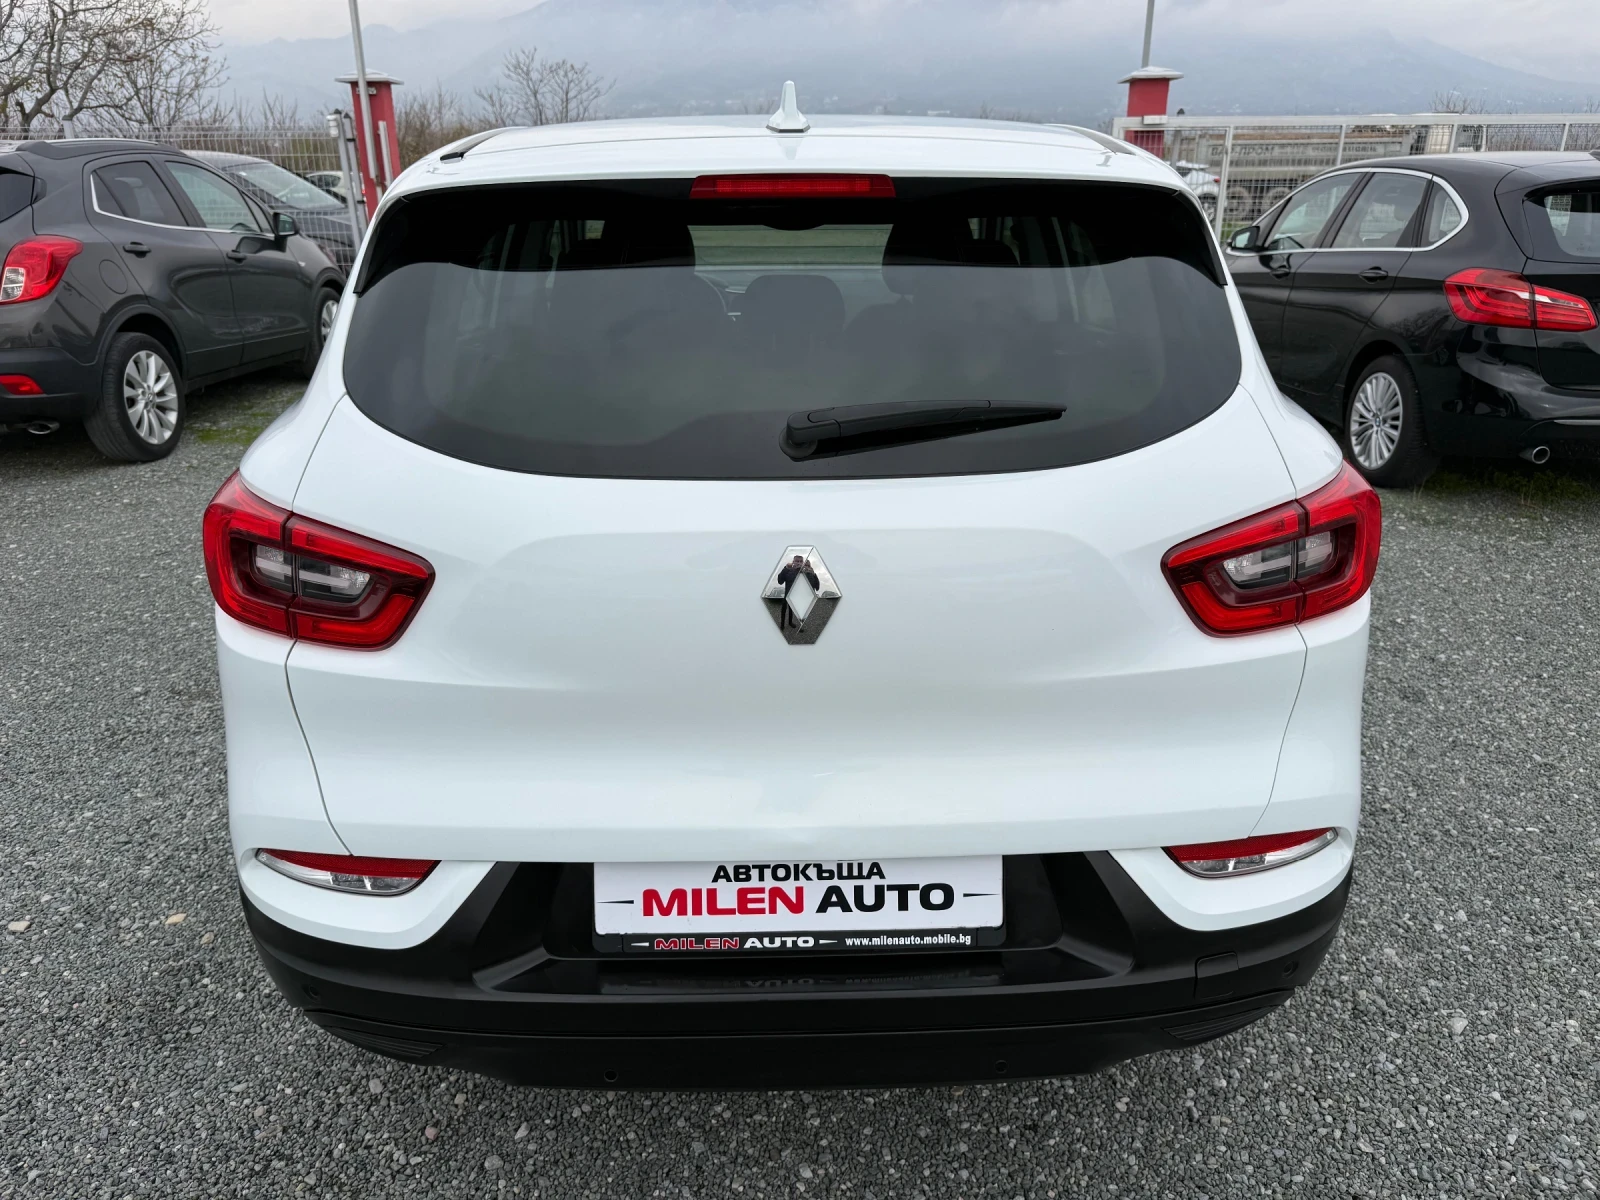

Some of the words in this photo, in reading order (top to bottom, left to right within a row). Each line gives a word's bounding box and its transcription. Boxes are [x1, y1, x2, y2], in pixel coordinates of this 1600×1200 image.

[711, 861, 886, 883] АВТОКЪЩА
[642, 886, 804, 917] MILEN
[815, 883, 955, 914] AUTO
[654, 937, 740, 950] MILEN
[743, 936, 815, 949] AUTO
[845, 933, 972, 946] www.milenauto.mobile.bg
